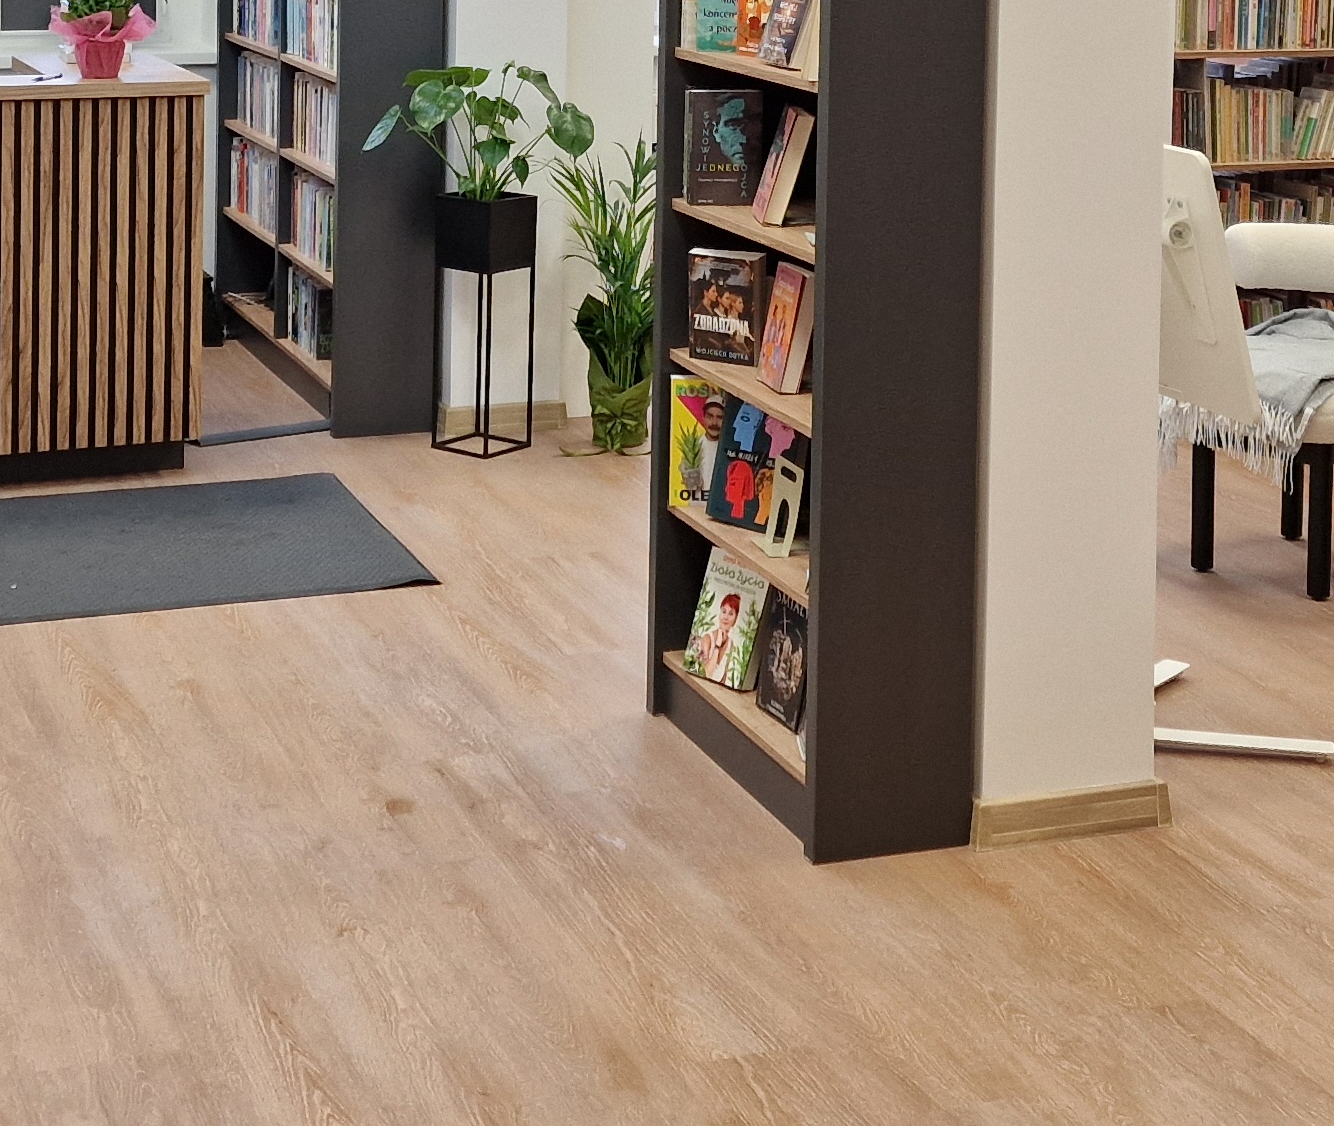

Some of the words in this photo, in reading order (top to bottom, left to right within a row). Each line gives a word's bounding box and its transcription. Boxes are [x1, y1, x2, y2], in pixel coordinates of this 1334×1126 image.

[695, 163, 748, 172] JEDNEGO
[694, 314, 751, 337] ZDRADZONA
[710, 562, 736, 579] Zioła
[736, 570, 765, 590] Życia
